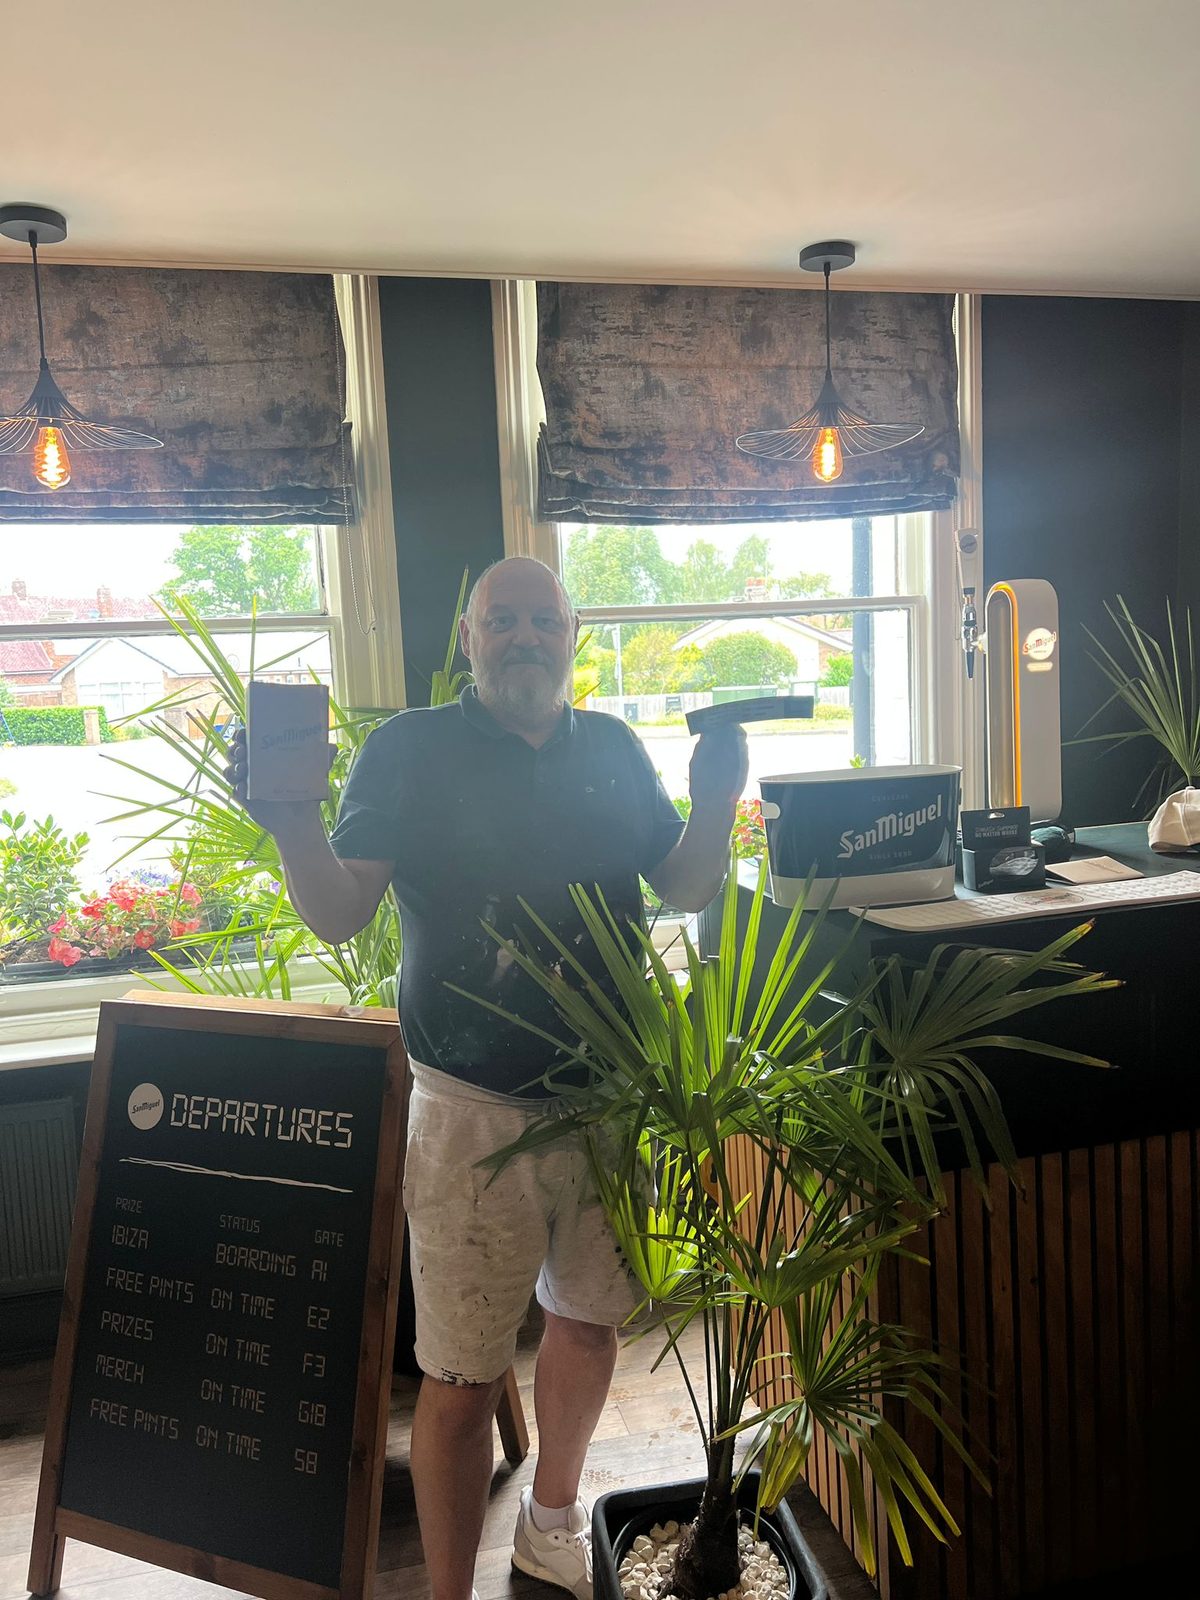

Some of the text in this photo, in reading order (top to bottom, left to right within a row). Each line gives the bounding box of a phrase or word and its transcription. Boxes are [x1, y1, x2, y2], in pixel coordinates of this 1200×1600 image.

[837, 794, 942, 859] SanMiguel
[131, 1099, 161, 1114] SanMiguel
[170, 1093, 354, 1149] DEPARTURES
[111, 1224, 149, 1250] IBIZA
[216, 1242, 297, 1277] BOARDING
[115, 1197, 345, 1247] PRIZE STATUS GATE
[106, 1267, 330, 1330] FREE PINTS ON TIME E2
[100, 1310, 326, 1378] PRIZES ON TIME F3
[95, 1353, 145, 1385] MERCH
[200, 1378, 223, 1403] ON
[231, 1384, 266, 1414] TIME
[90, 1398, 128, 1427] FREE
[133, 1408, 179, 1440] PINTS
[195, 1425, 219, 1449] ON
[225, 1431, 261, 1461] TIME
